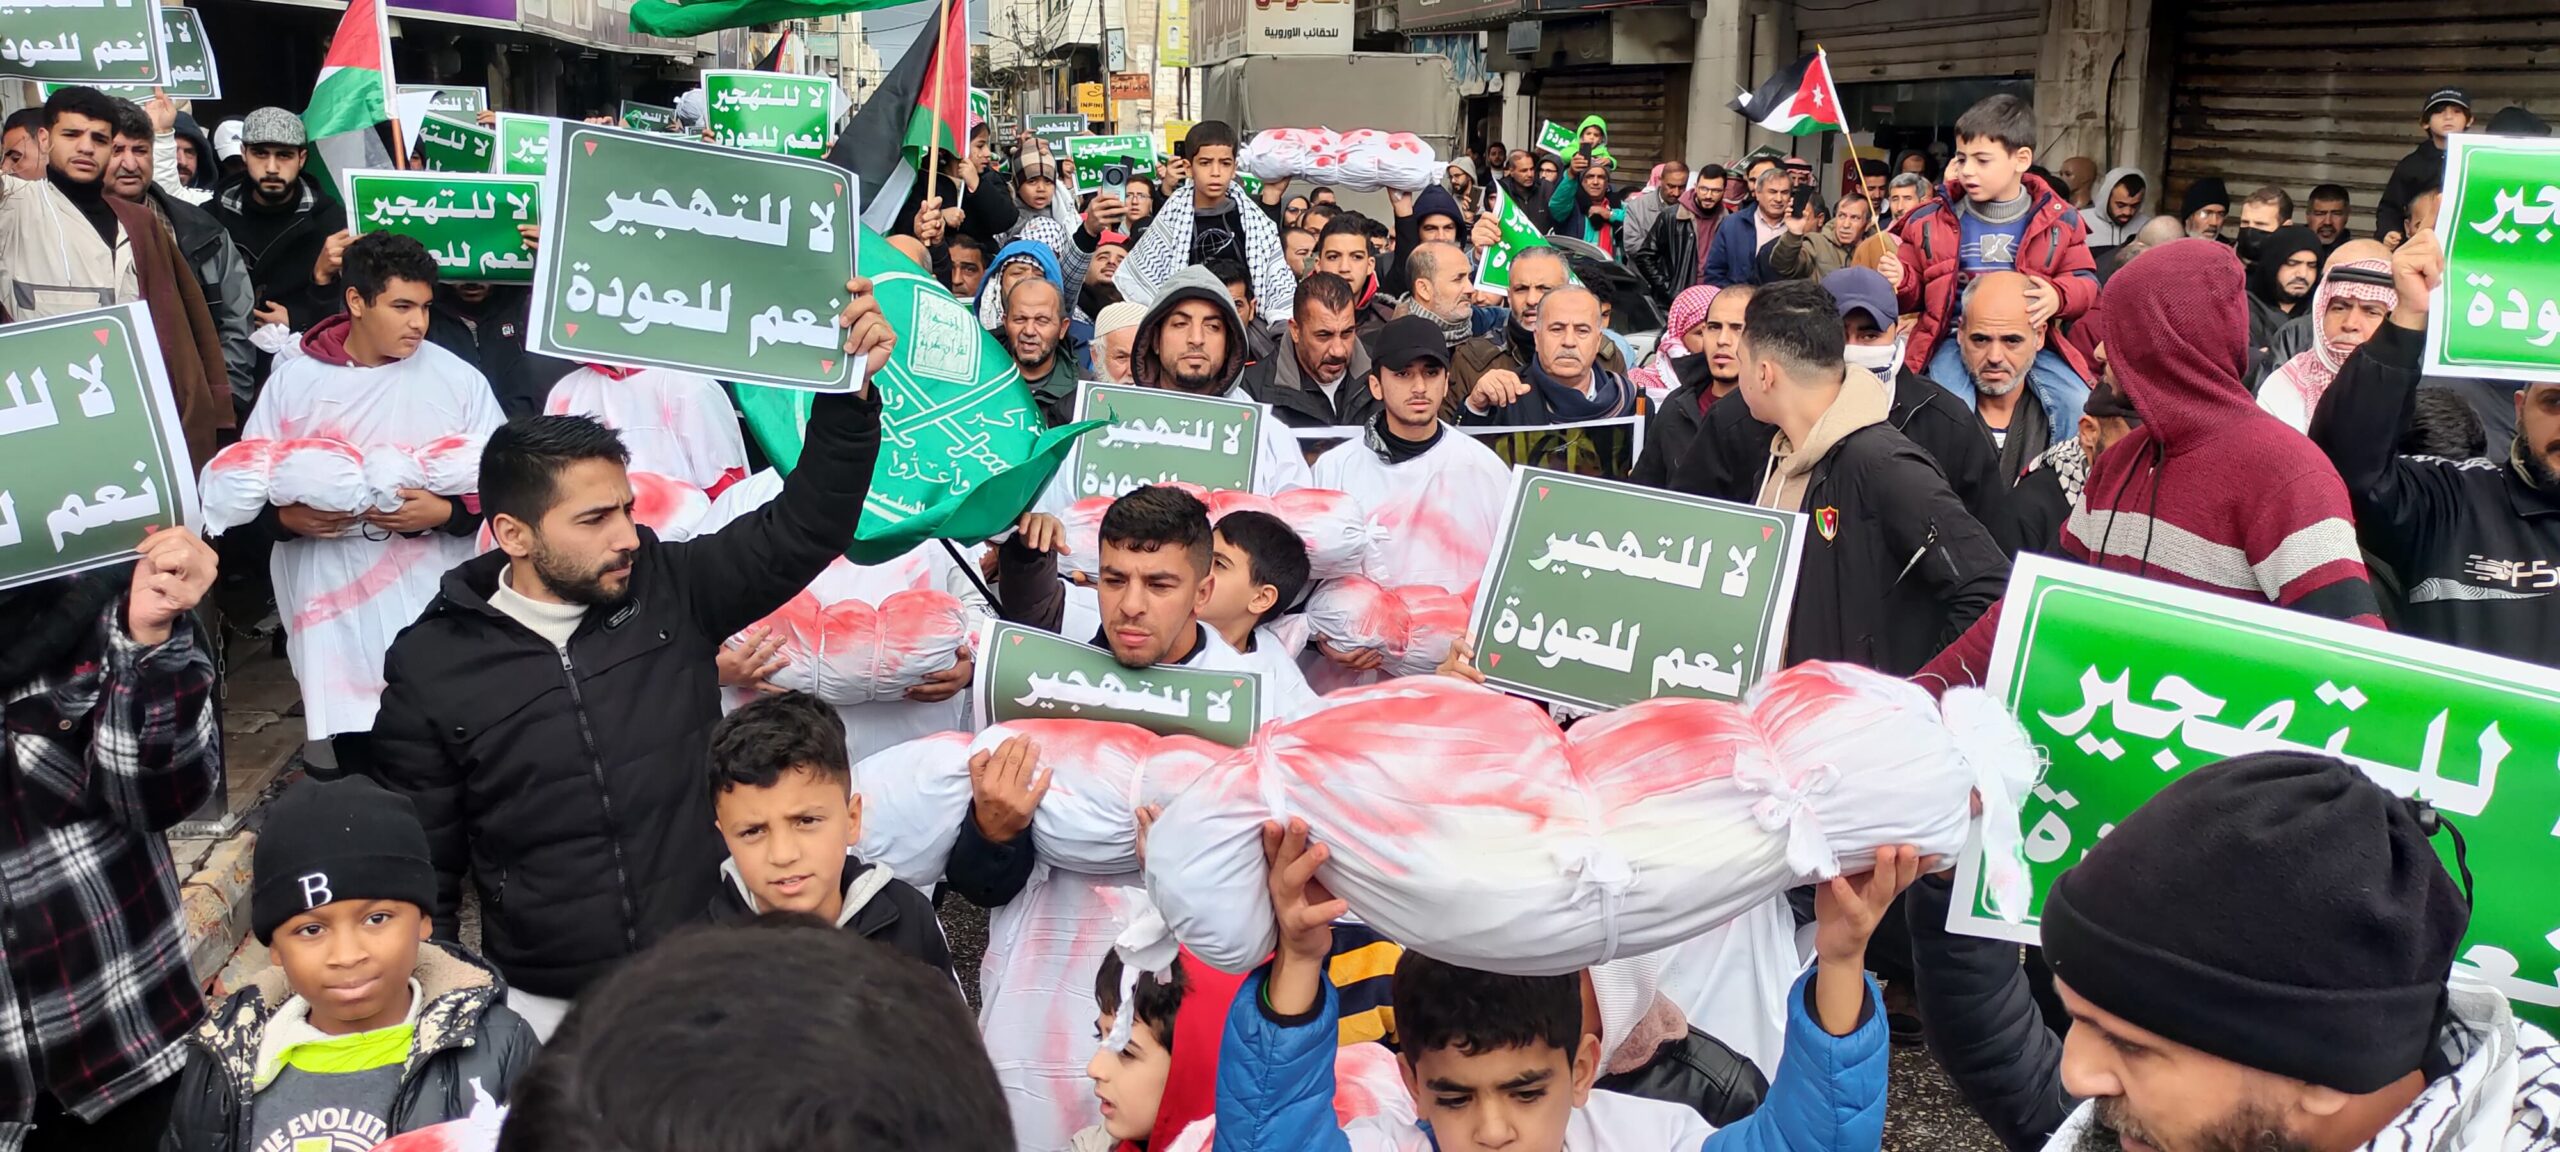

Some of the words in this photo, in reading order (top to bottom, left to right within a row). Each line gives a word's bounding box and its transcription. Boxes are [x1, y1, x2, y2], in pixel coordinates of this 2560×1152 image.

[1, 32, 82, 67] للعود
[176, 21, 192, 42] لا
[1304, 28, 1338, 38] للحقائب
[93, 32, 149, 71] نعم
[171, 59, 206, 88] نعم
[465, 97, 475, 111] لا
[711, 83, 800, 111] للتهجير
[808, 86, 824, 108] لا
[715, 123, 779, 149] للعودة
[784, 126, 822, 155] نعم
[1072, 121, 1079, 131] لا
[1138, 136, 1147, 148] لا
[474, 136, 489, 157] لا
[365, 189, 496, 225] للتهجير
[506, 192, 531, 220] لا
[589, 188, 791, 246] للتهجير
[808, 200, 834, 252] لا
[566, 261, 731, 335] للعودة
[750, 298, 840, 357] نعم
[69, 354, 115, 418] لا
[1098, 416, 1215, 452] للتهجير
[1223, 422, 1242, 455] لا
[46, 460, 161, 553] نعم
[1528, 530, 1711, 590] للتهجير
[1721, 545, 1757, 597] لا
[1493, 596, 1640, 673] للعودة
[1651, 642, 1744, 698] نعم
[1014, 670, 1191, 718] للتهجير
[1206, 689, 1233, 723] لا
[298, 872, 333, 910] B
[288, 1107, 387, 1144] EVOLUT
